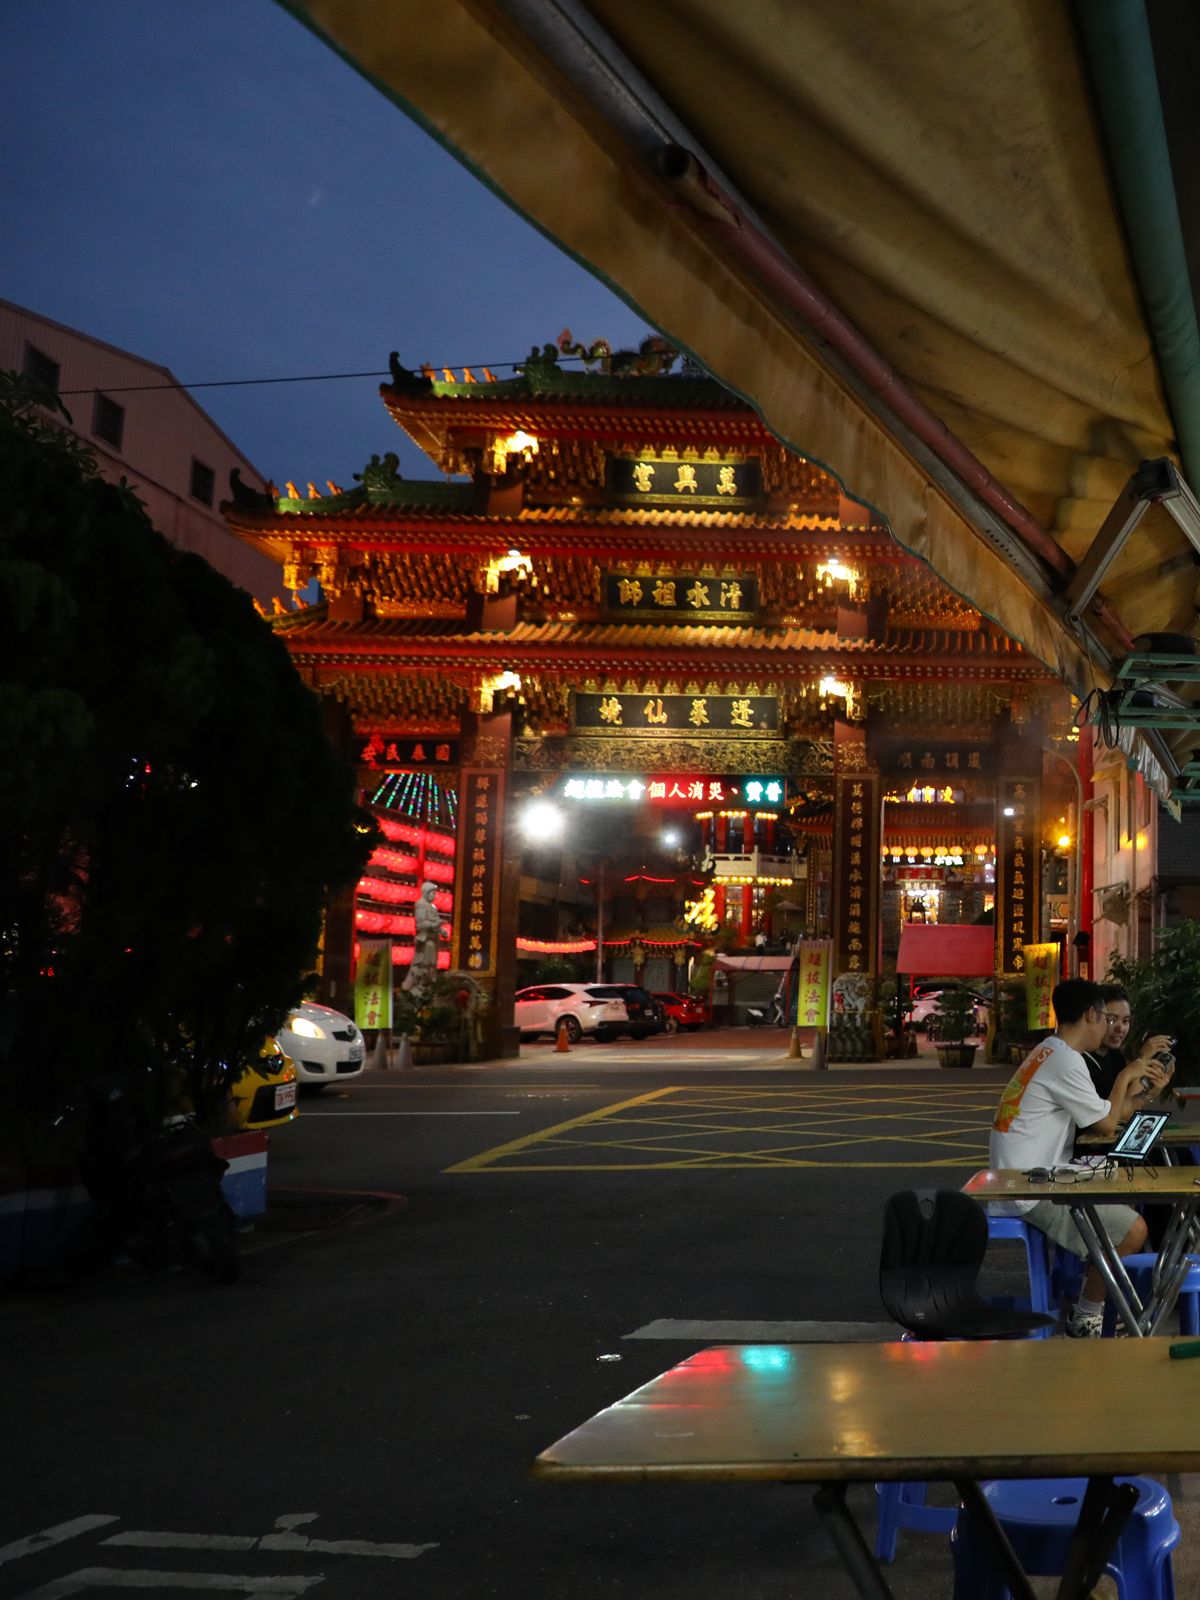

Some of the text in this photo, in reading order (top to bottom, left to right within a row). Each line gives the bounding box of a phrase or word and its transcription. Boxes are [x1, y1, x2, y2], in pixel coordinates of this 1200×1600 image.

[632, 462, 737, 496] 萬興宮
[617, 578, 744, 609] 清水祖師
